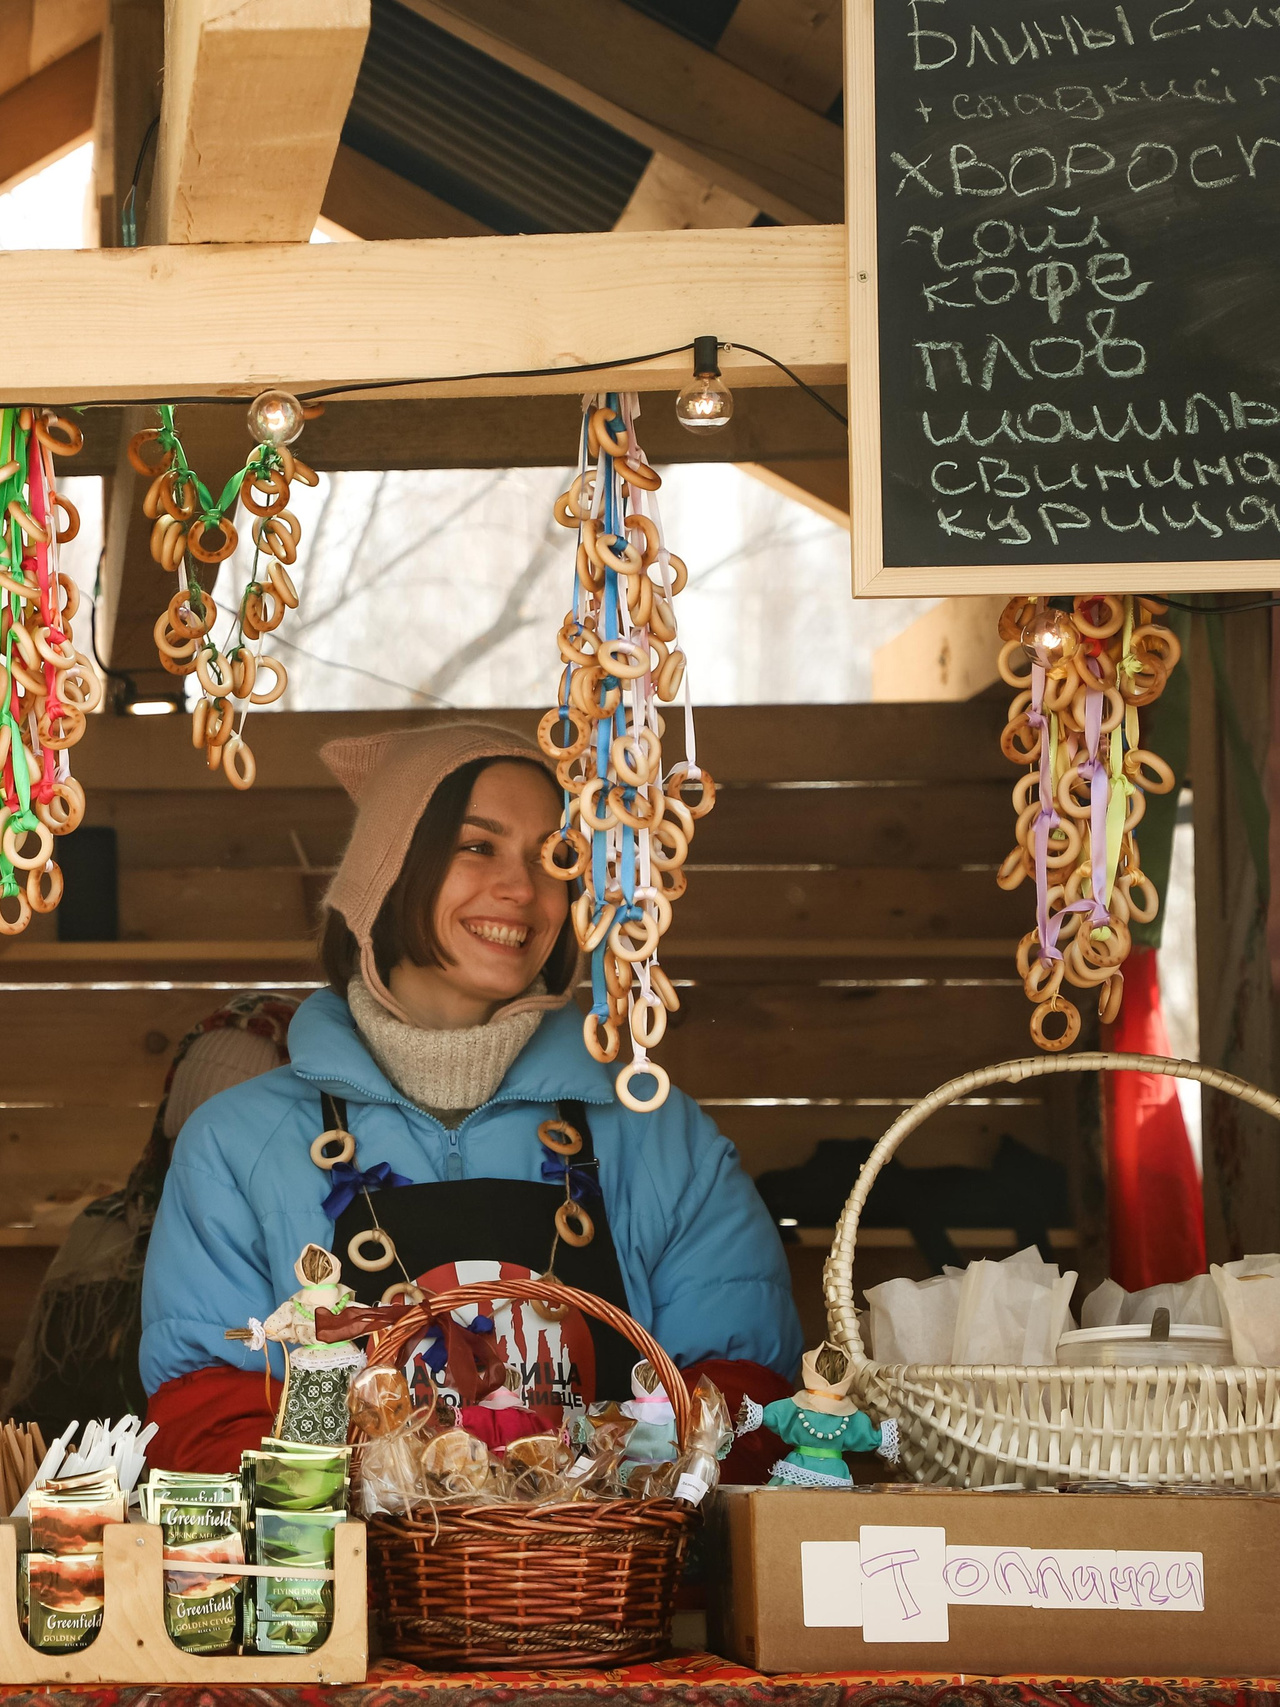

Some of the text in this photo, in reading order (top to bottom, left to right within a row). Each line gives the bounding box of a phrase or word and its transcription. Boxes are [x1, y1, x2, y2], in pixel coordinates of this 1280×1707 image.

[907, 206, 1111, 271] чай
[922, 253, 1154, 324] кофе
[913, 308, 1147, 391] плов
[166, 1508, 232, 1527] Greenfield
[177, 1595, 232, 1618] Greenfield
[47, 1613, 103, 1629] Greenfield
[176, 1620, 208, 1632] GOLDEN
[43, 1634, 76, 1642] GOLDEN
